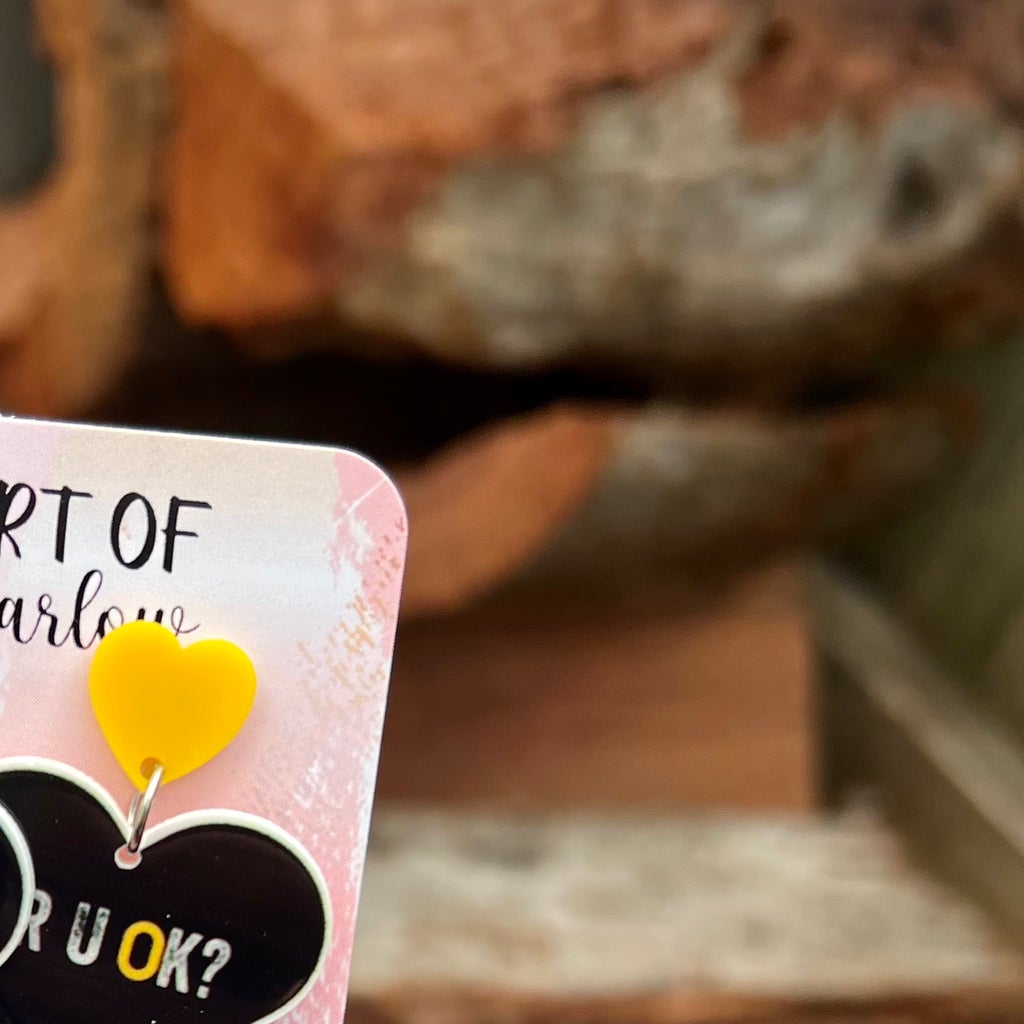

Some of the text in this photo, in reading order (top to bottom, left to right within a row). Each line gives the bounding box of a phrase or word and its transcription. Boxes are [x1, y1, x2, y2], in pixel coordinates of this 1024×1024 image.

[109, 491, 213, 574] OF
[28, 888, 232, 999] R U OK?
